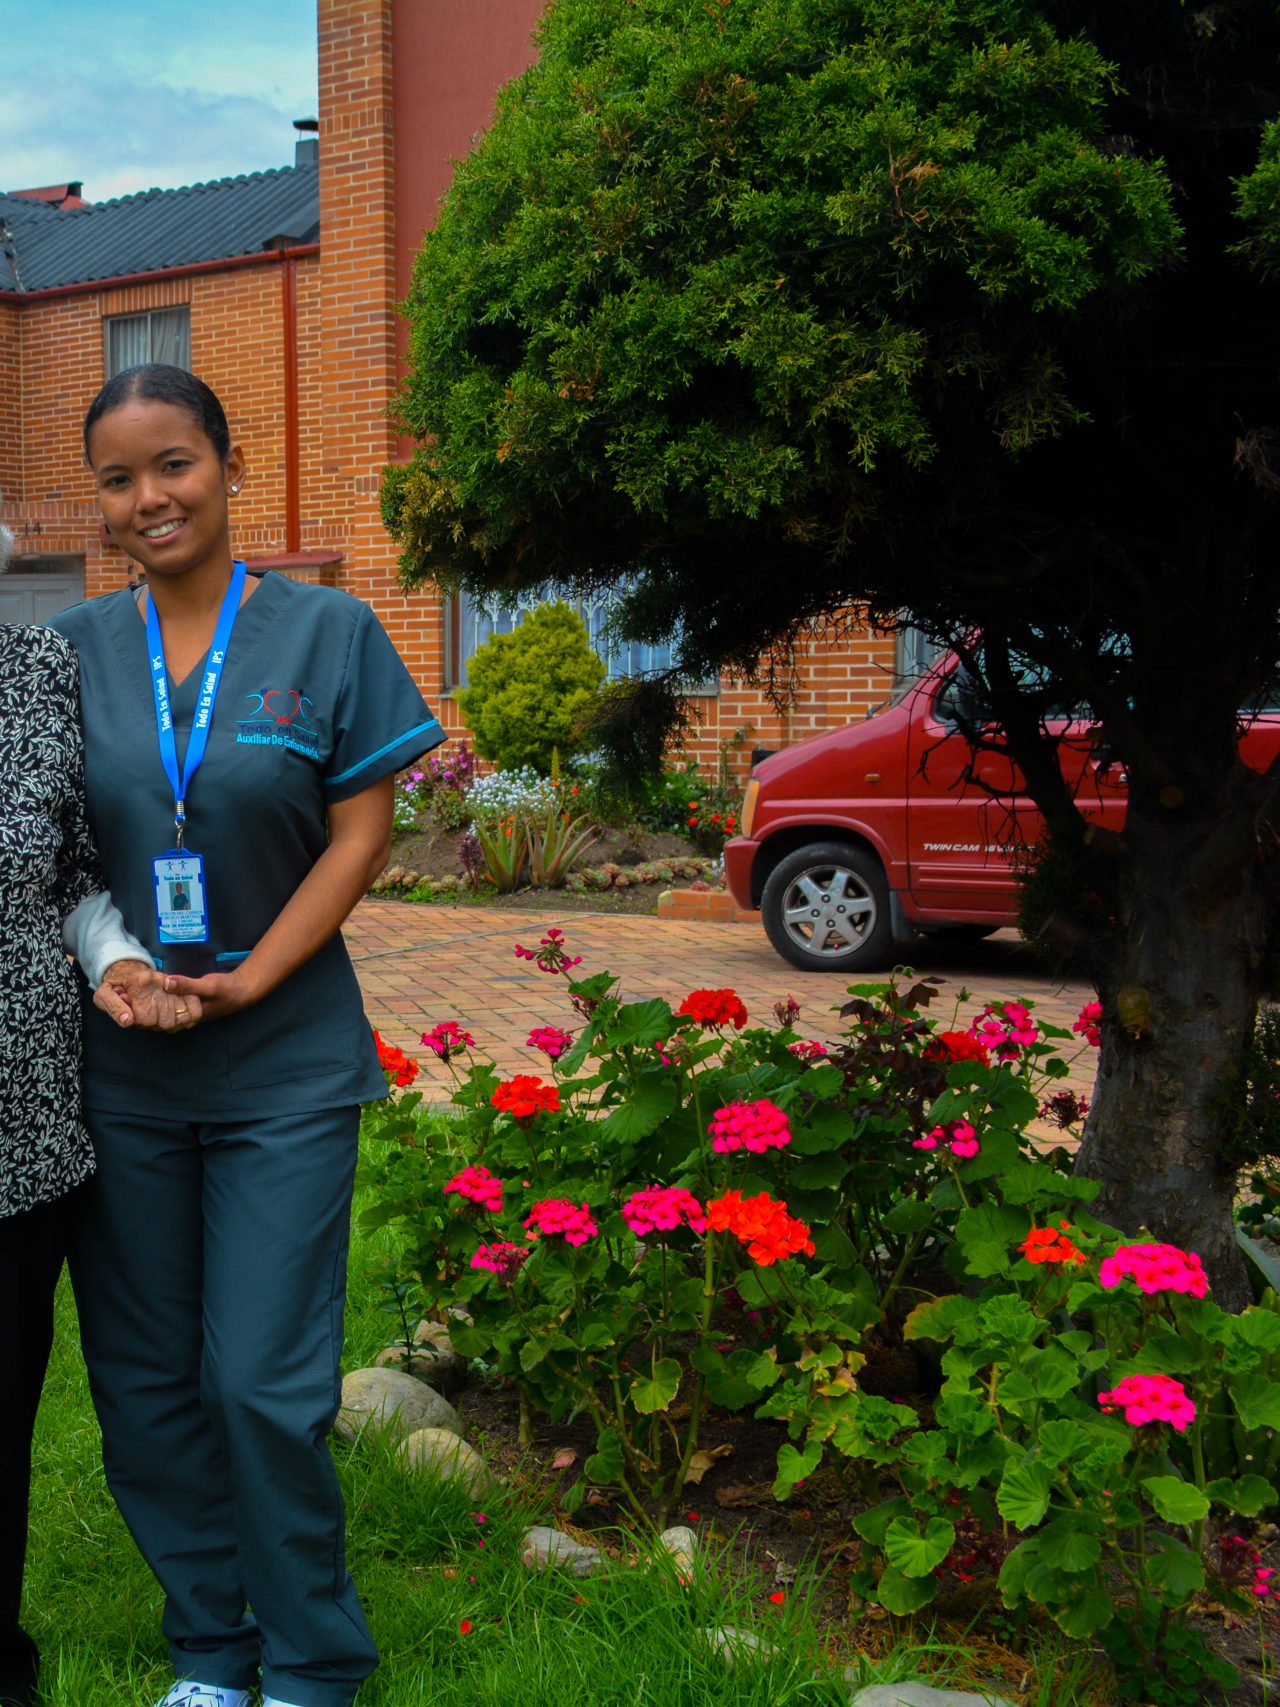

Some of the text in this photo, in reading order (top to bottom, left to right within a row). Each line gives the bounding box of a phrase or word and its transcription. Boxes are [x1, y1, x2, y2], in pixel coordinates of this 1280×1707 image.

[25, 522, 41, 536] 14
[152, 655, 171, 733] Todo En Salud IPS
[196, 650, 225, 728] Todo En Salud IPS
[236, 733, 271, 746] Auxiliar
[272, 734, 284, 746] De
[923, 843, 952, 852] TWIN
[952, 843, 980, 853] CAM
